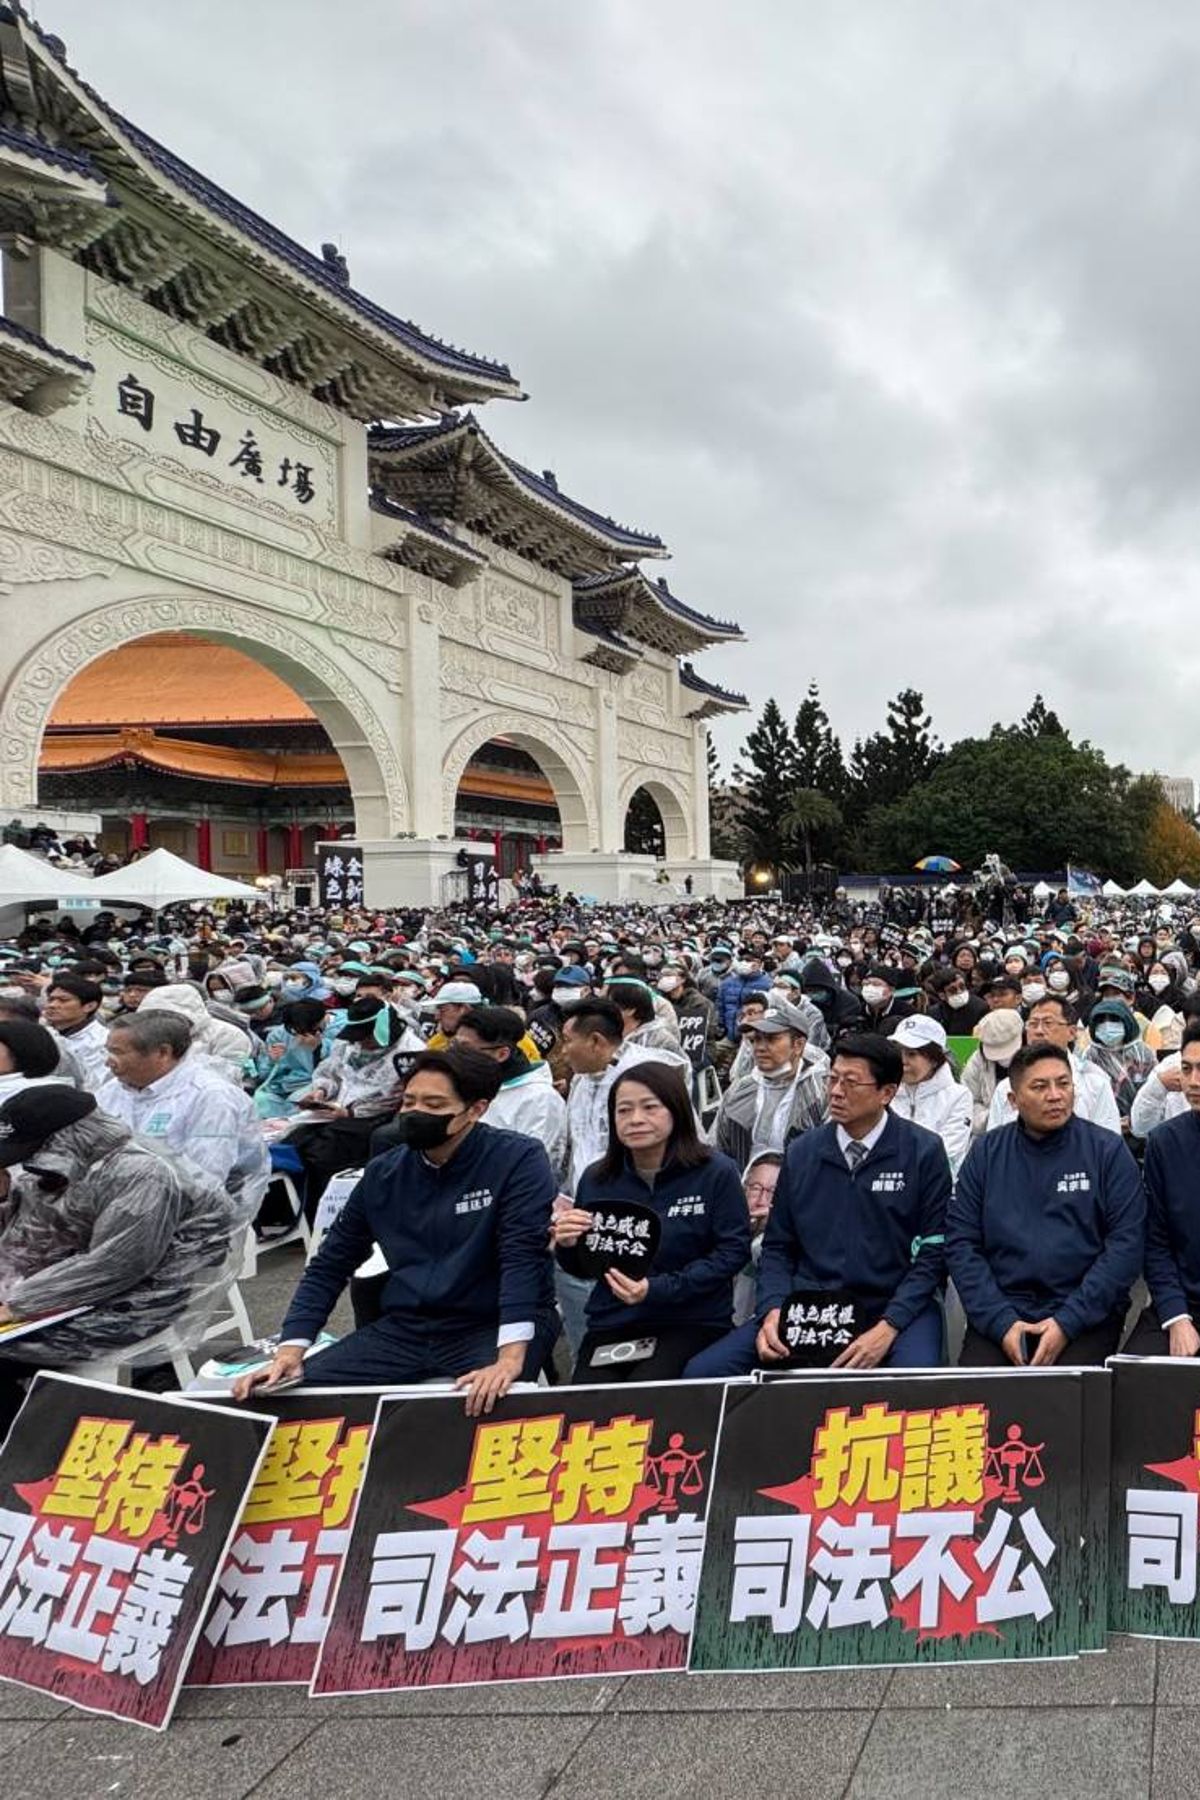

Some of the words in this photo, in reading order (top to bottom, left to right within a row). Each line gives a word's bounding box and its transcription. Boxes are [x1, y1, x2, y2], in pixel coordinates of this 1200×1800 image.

[118, 373, 317, 504] 自由廣場
[585, 1234, 648, 1257] 司法不公
[785, 1326, 853, 1347] 司法不公
[41, 1419, 190, 1537] 堅持
[461, 1416, 652, 1524] 堅持
[812, 1406, 987, 1511] 抗議
[361, 1513, 707, 1651] 司法正義
[729, 1507, 1056, 1634] 司法不公
